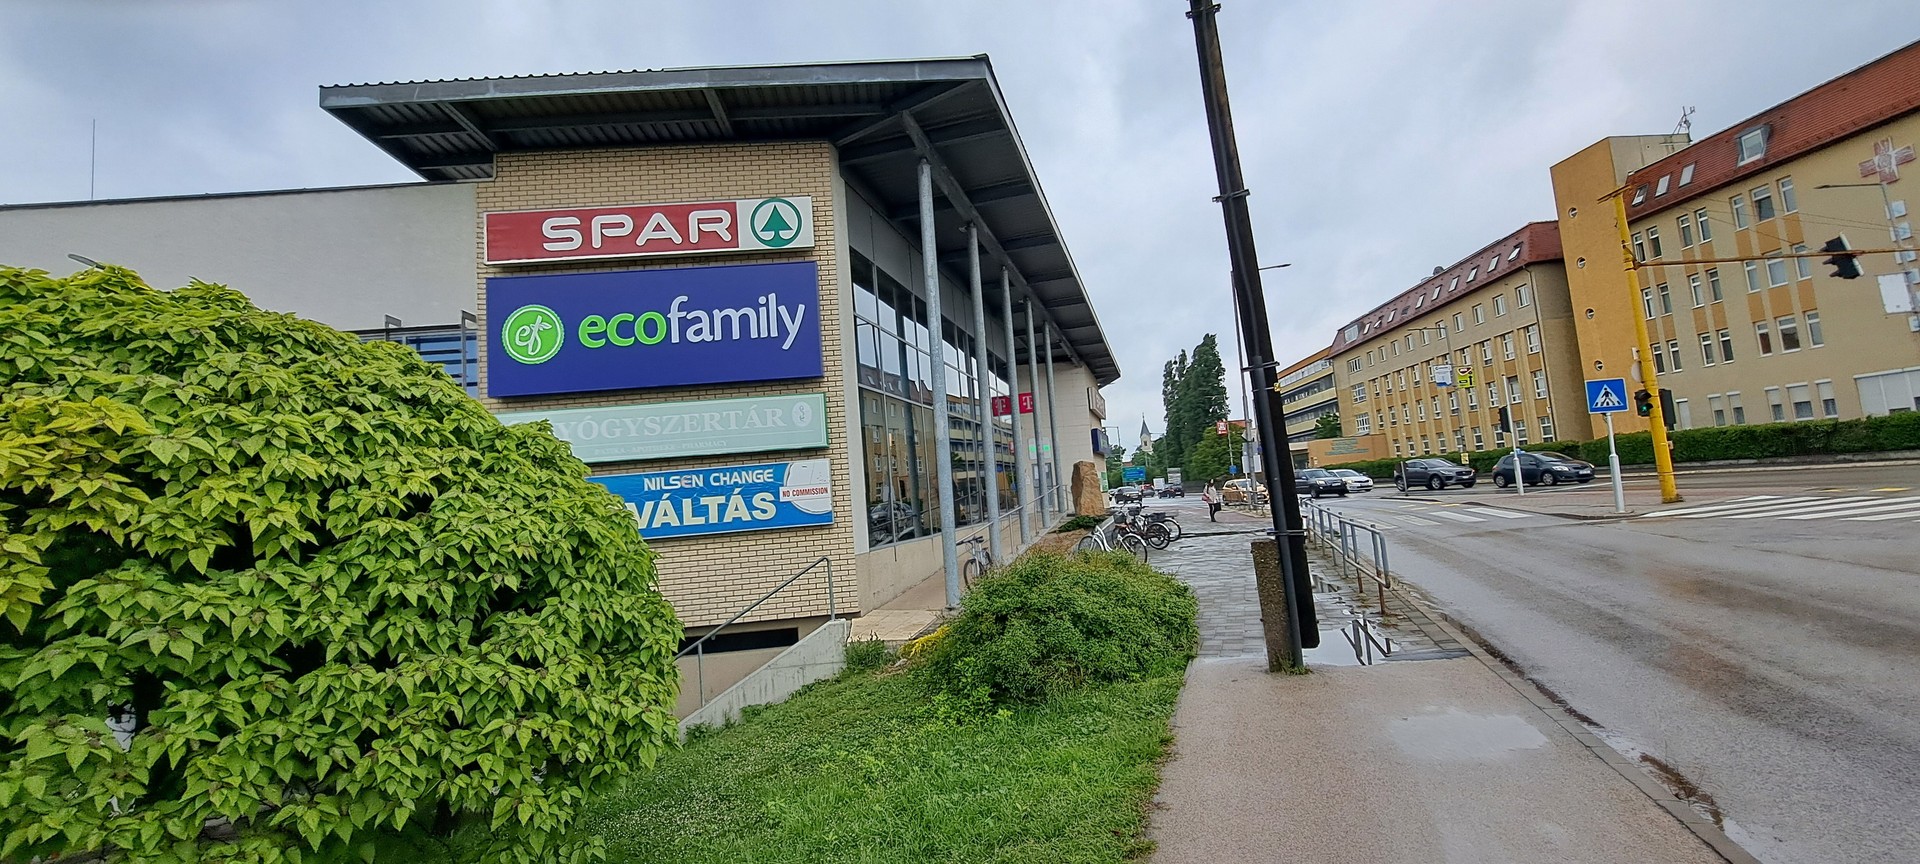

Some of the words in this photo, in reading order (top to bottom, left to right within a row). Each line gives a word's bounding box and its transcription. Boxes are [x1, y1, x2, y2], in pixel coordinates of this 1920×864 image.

[541, 209, 732, 251] SPAR
[578, 293, 805, 350] ecofamily
[554, 405, 786, 440] YÓGYSZERTÁR
[643, 474, 704, 492] NILSEN
[709, 468, 774, 487] CHANGE
[782, 490, 791, 498] NO
[791, 487, 828, 497] COMMISSION
